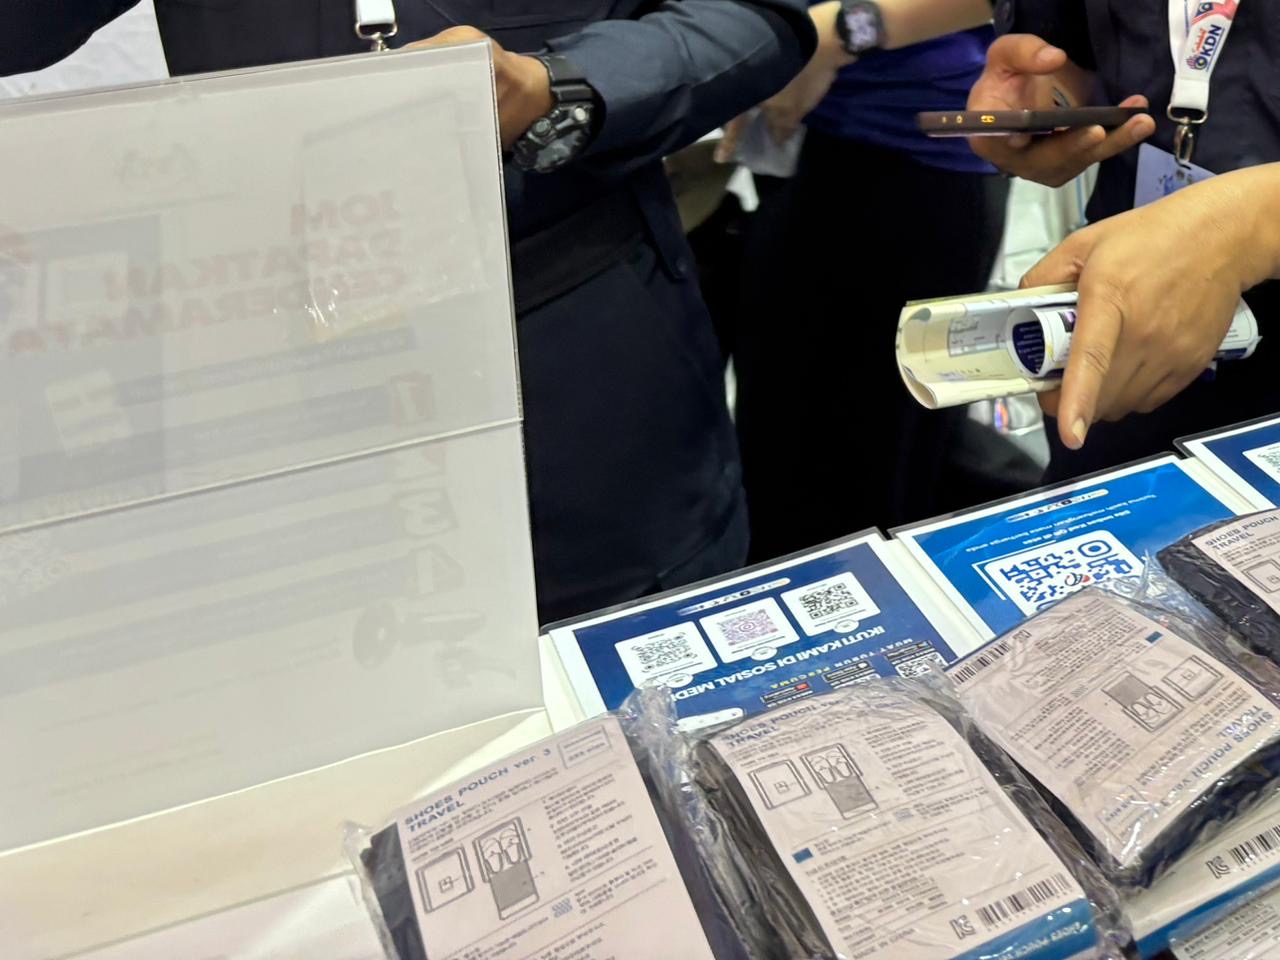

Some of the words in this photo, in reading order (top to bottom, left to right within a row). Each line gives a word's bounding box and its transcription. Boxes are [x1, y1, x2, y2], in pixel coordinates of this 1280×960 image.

[1205, 529, 1241, 546] SHOES
[1243, 515, 1279, 530] POUCH
[1212, 533, 1255, 550] TRAVEL
[843, 625, 885, 646] IKUTI
[777, 654, 798, 668] DI
[798, 640, 843, 661] KAMI
[715, 661, 777, 687] SOSIAL
[770, 666, 831, 689] PERCUMA
[728, 725, 777, 748] TRAVEL
[1192, 742, 1233, 778] POUCH
[405, 794, 454, 825] SHOES
[458, 767, 509, 797] POUCH
[408, 800, 465, 833] TRAVEL
